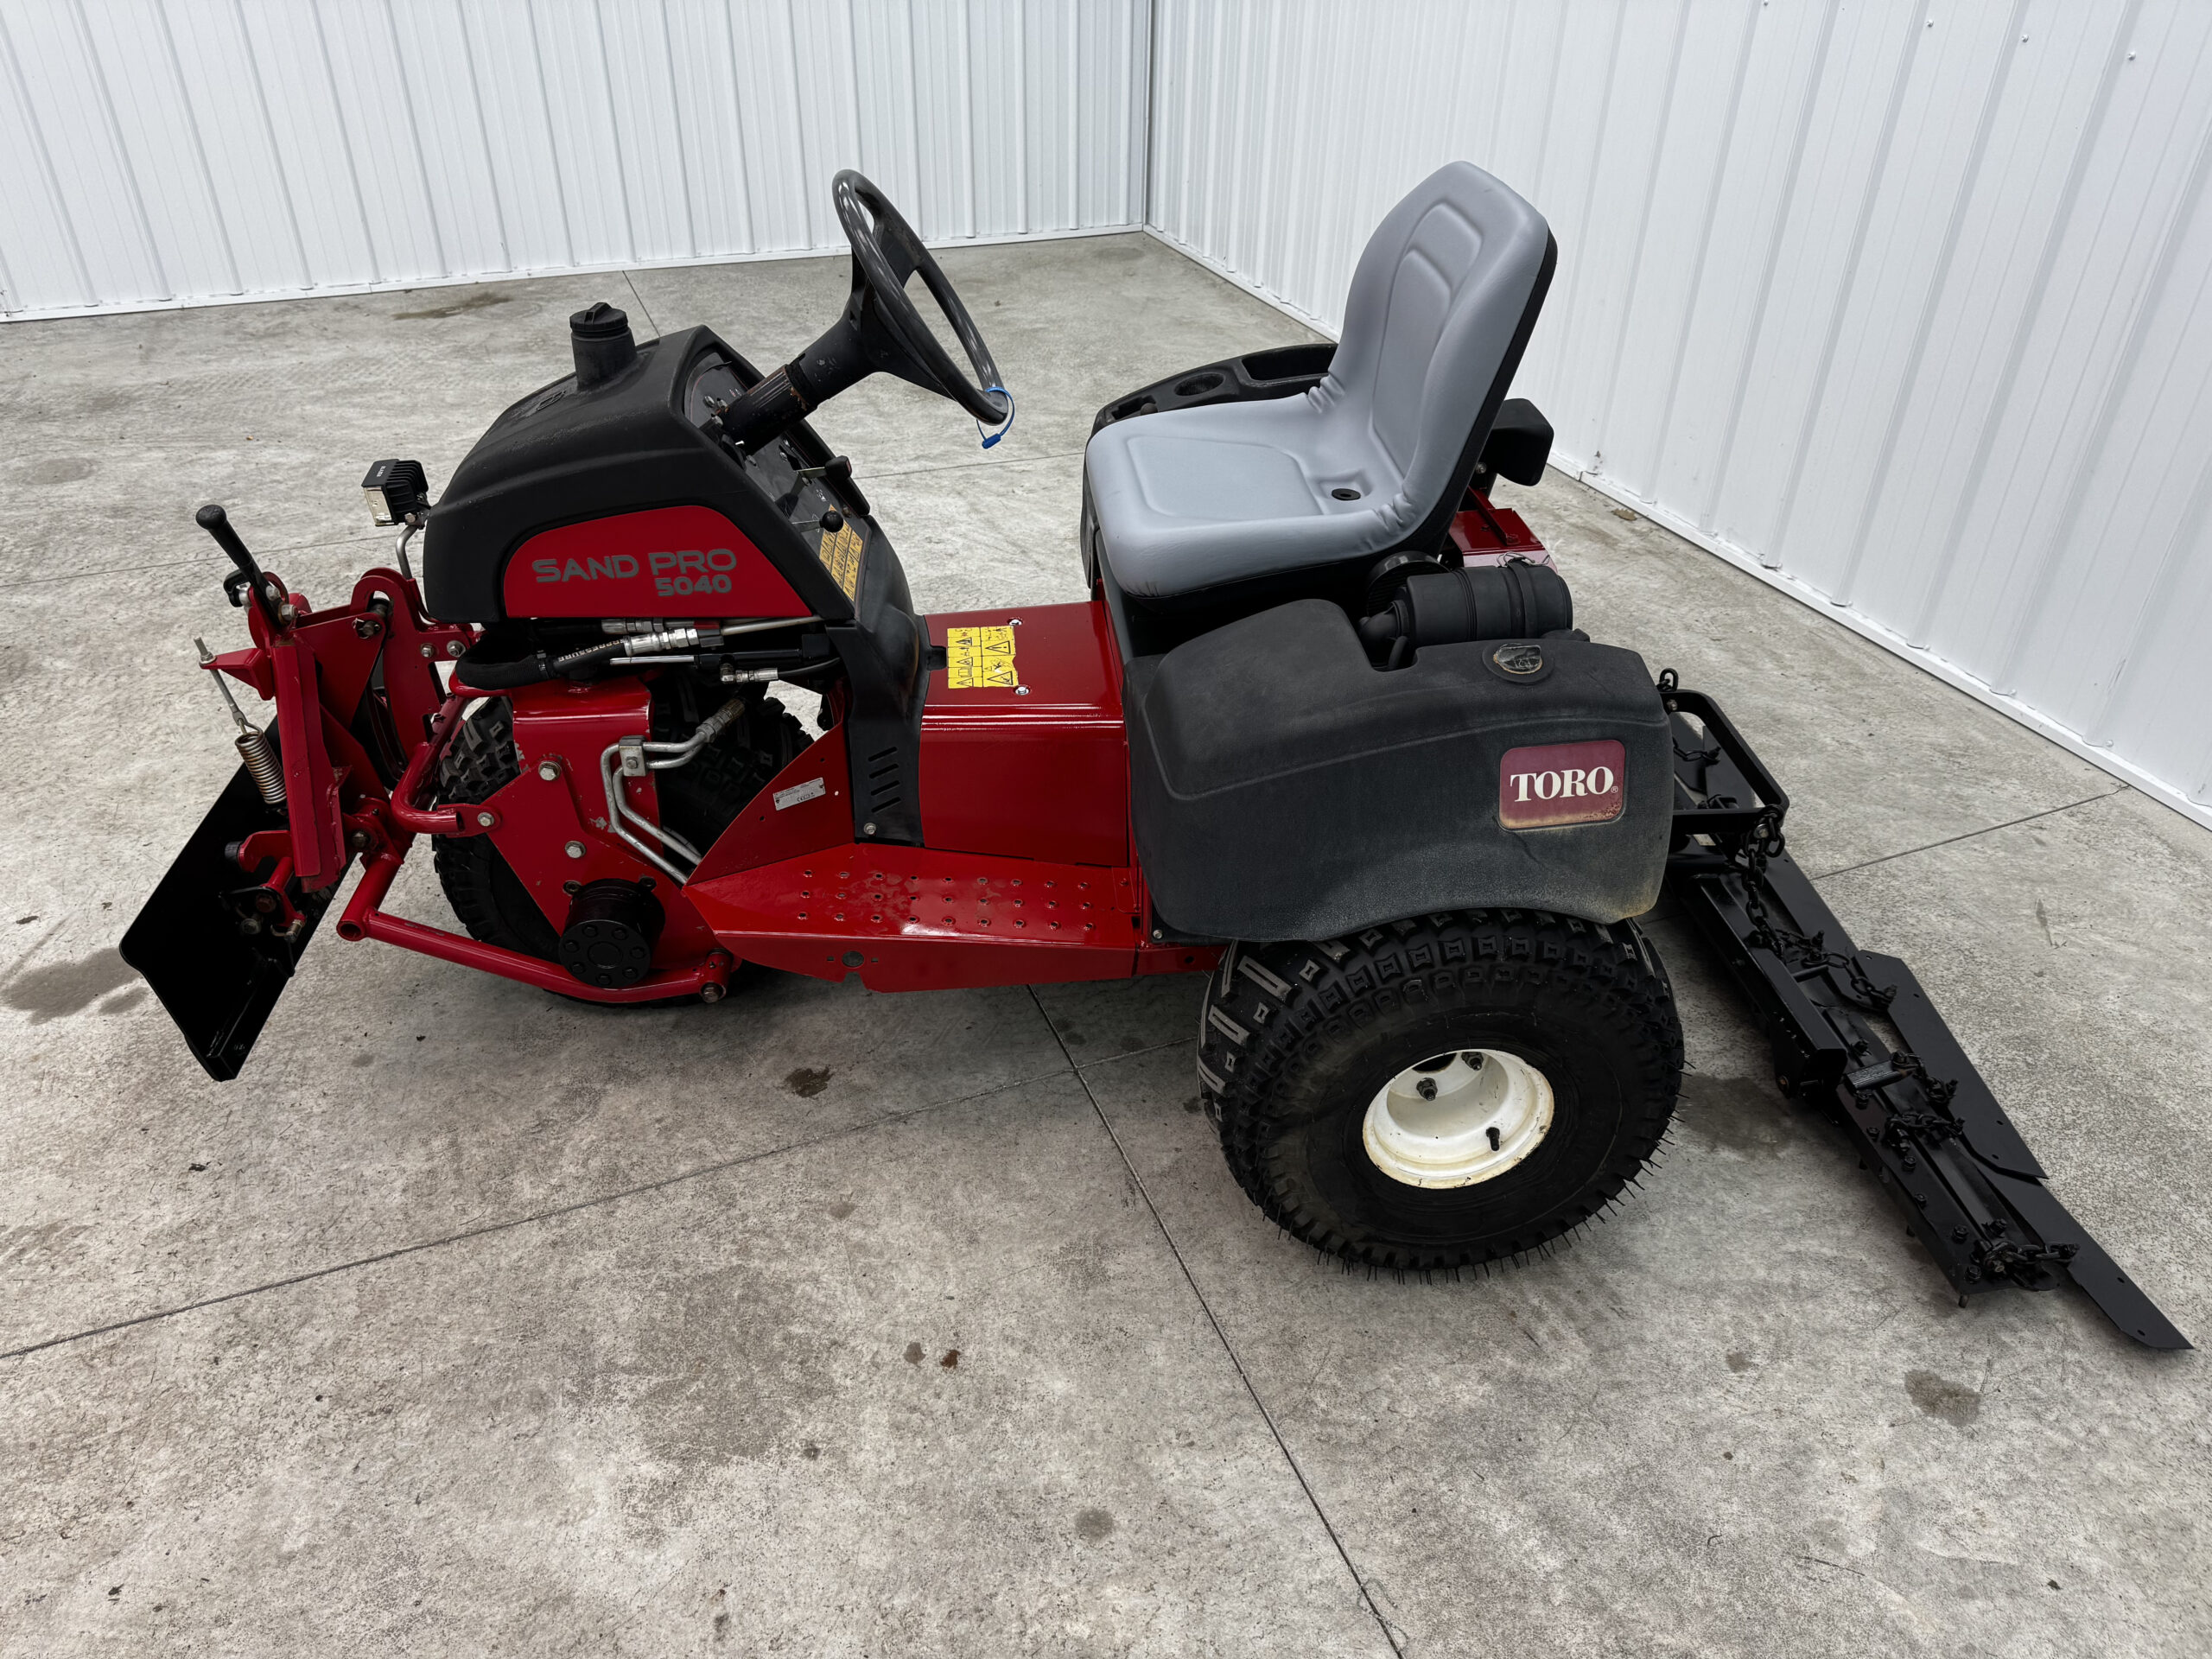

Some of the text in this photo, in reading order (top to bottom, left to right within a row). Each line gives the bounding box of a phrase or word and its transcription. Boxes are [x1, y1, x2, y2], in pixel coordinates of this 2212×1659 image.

[532, 549, 736, 582] SAND PRO
[655, 575, 732, 596] 5040
[1510, 766, 1613, 802] TORO
